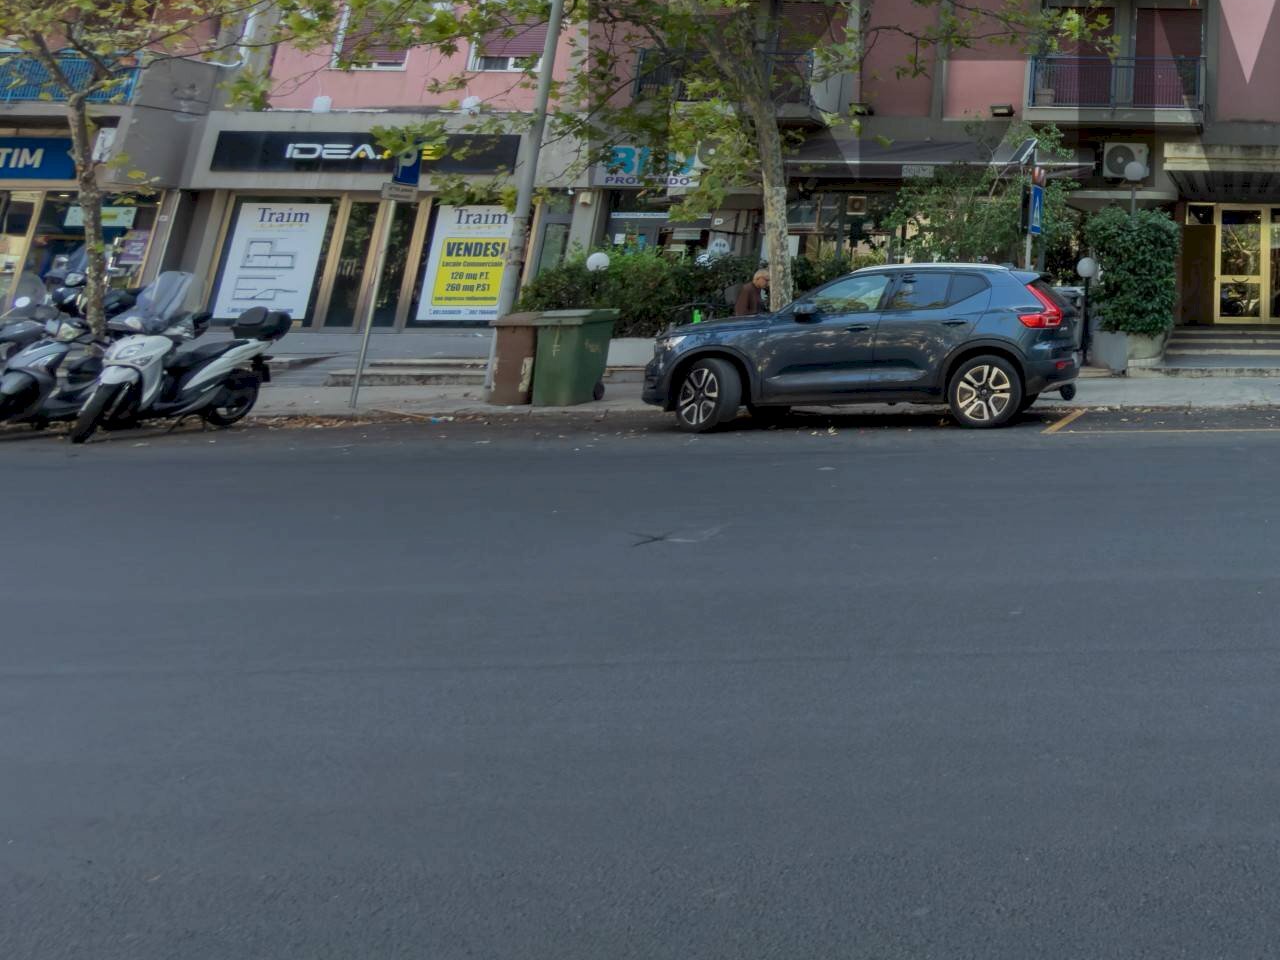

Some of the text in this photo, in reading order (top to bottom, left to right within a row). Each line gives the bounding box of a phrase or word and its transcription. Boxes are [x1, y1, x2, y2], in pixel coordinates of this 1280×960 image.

[0, 148, 44, 169] TIM
[258, 207, 310, 223] Traim
[454, 208, 509, 225] Traim
